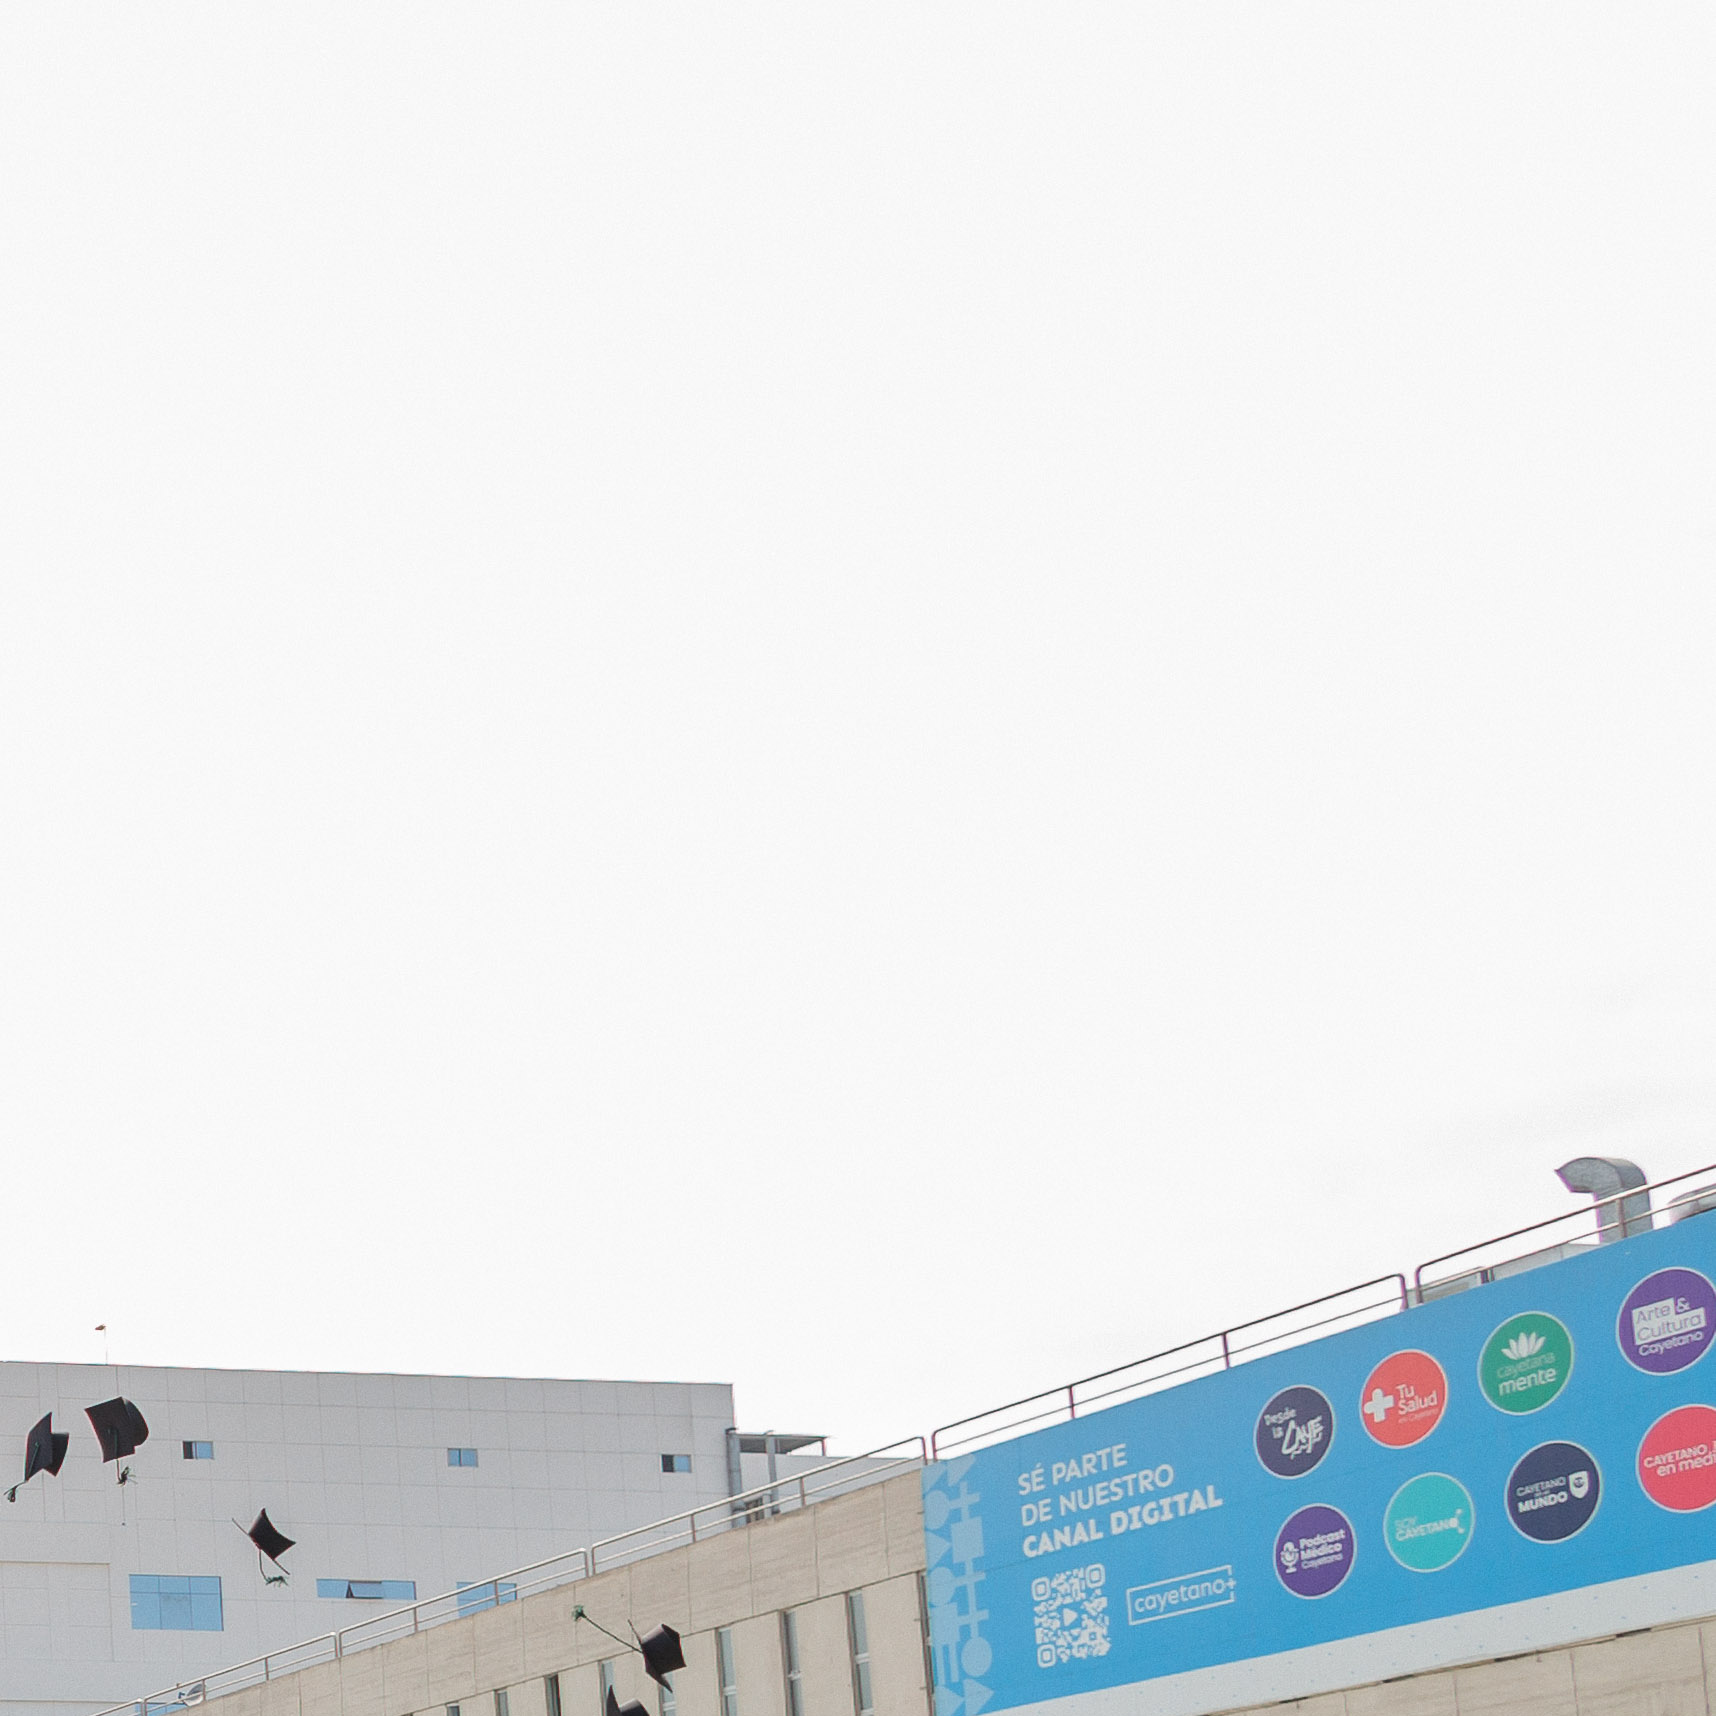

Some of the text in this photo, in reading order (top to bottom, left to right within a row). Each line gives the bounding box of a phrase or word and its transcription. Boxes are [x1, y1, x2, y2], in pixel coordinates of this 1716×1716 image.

[1636, 1297, 1690, 1324] Arte &
[1638, 1314, 1702, 1341] Cultura
[1639, 1331, 1704, 1356] Cayetano
[1396, 1384, 1415, 1401] Tu
[1498, 1368, 1557, 1396] mente
[1398, 1390, 1438, 1415] Salud
[1644, 1444, 1708, 1468] CAYETANO
[1018, 1443, 1128, 1496] SÉ PARTE
[1657, 1464, 1676, 1477] en
[1021, 1464, 1175, 1527] DE NUESTRO
[1516, 1476, 1567, 1497] CAYETANO
[1518, 1491, 1568, 1513] MUNDO
[1023, 1485, 1224, 1558] CANAL DIGITAL
[1299, 1529, 1346, 1550] Podcast
